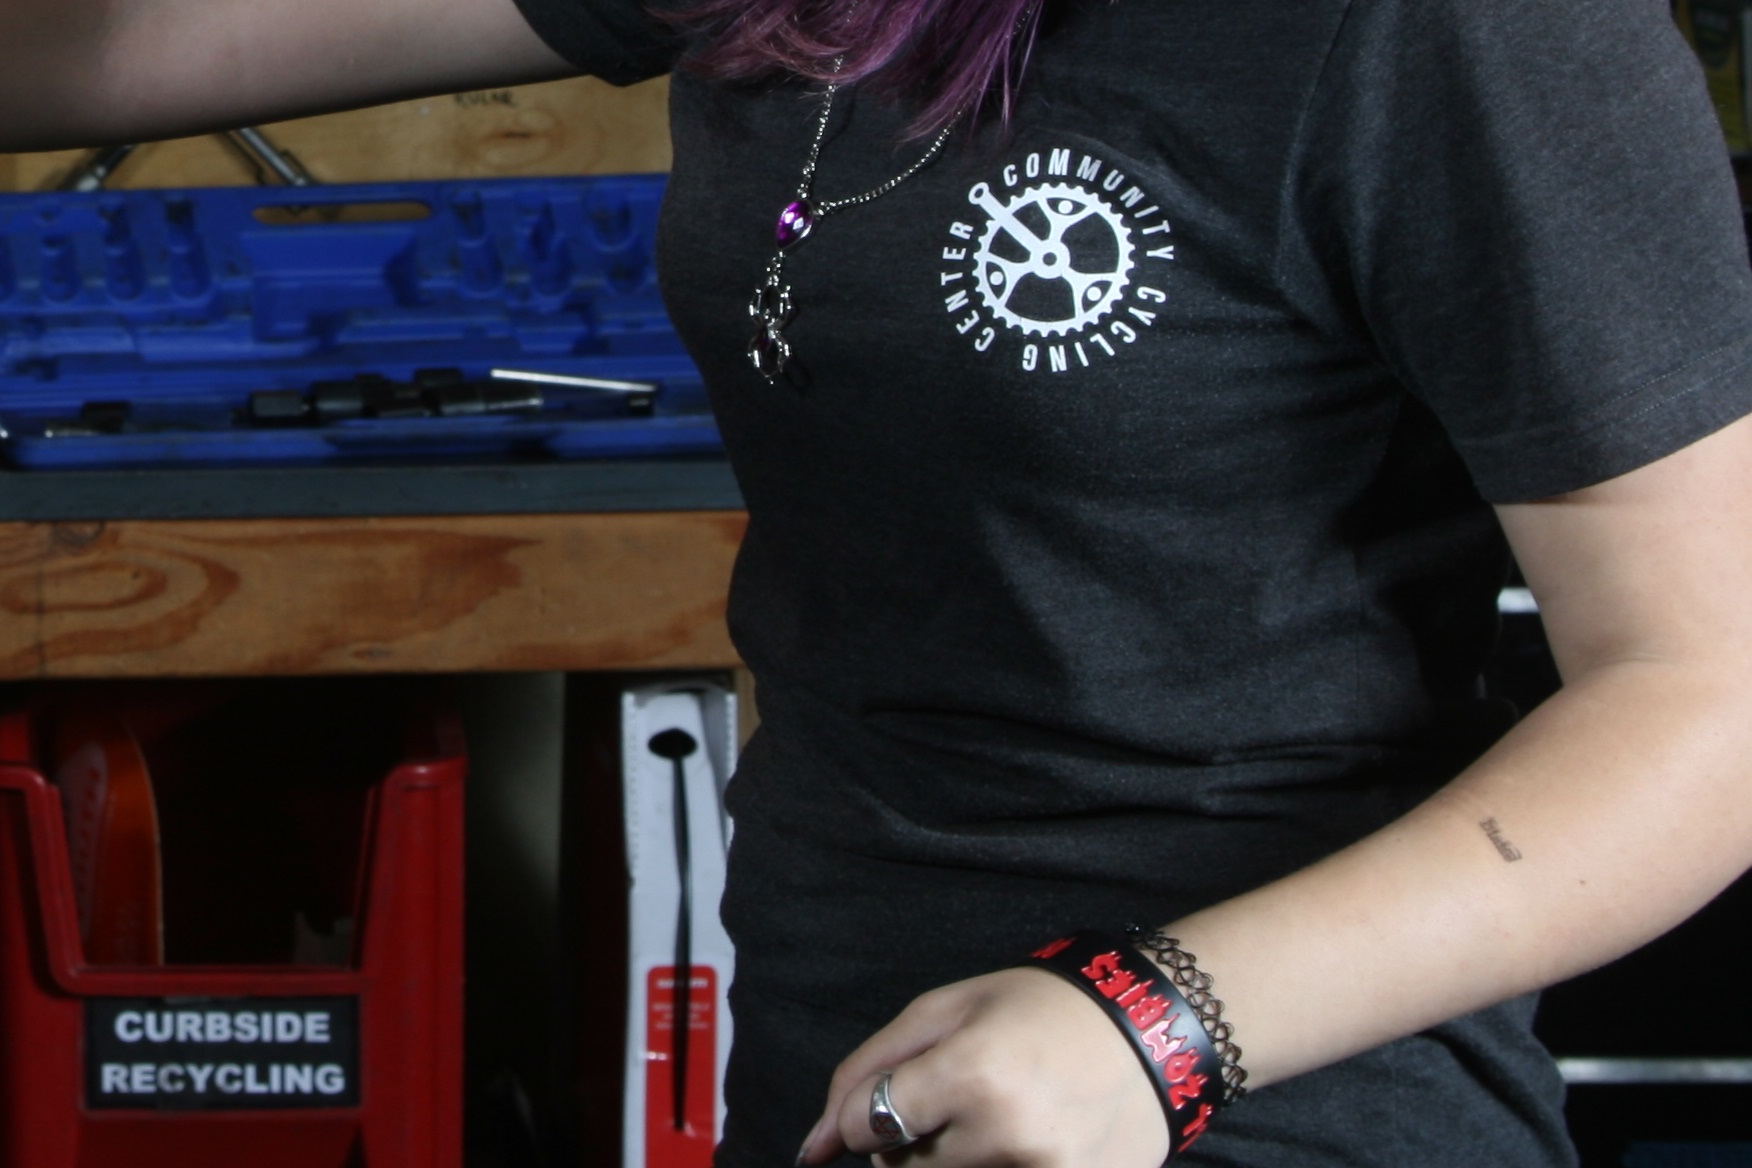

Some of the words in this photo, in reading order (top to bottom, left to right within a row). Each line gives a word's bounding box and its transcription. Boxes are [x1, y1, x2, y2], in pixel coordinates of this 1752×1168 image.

[1003, 147, 1175, 261] COMMUNITY
[940, 220, 997, 352] CENTER
[1022, 285, 1167, 372] CYCLING
[115, 1012, 331, 1043] CURBSIDE
[1079, 949, 1211, 1112] ZOMBIES
[101, 1061, 346, 1095] RECYCLING
